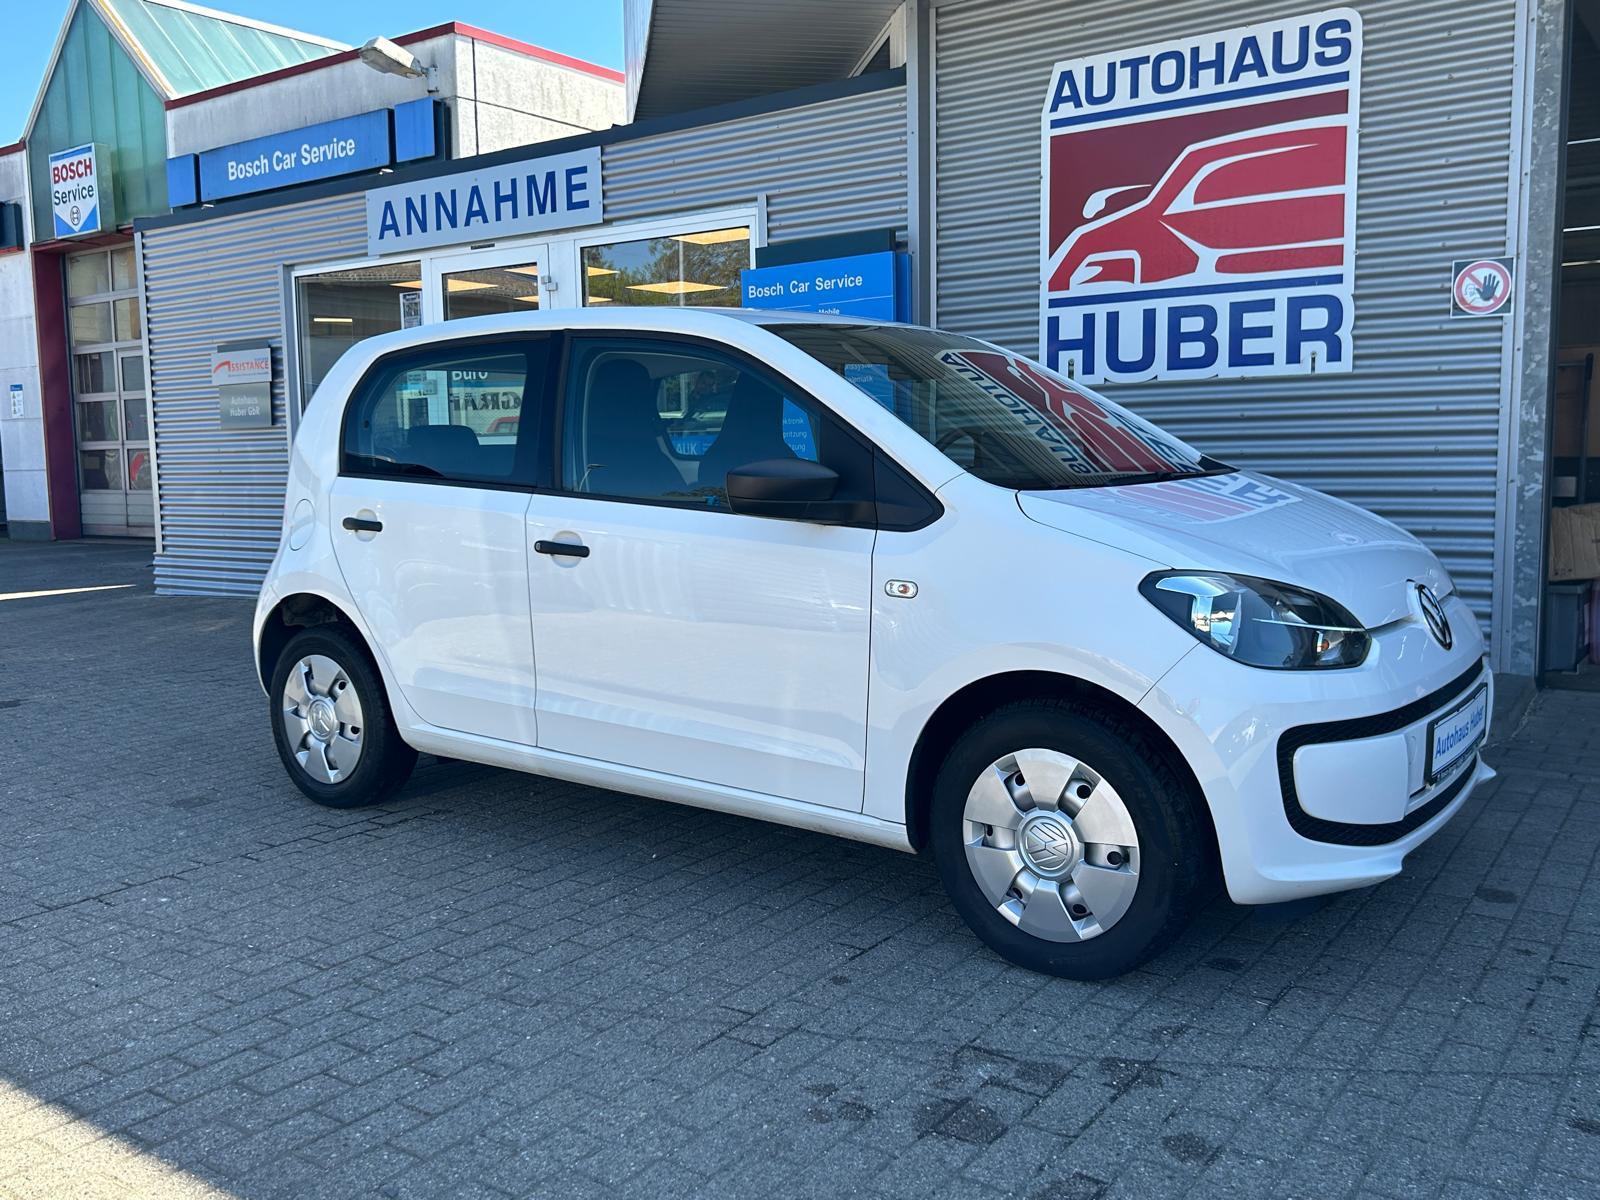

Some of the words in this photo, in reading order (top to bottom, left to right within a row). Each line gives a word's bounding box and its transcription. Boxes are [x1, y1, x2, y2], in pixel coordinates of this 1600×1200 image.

[1050, 18, 1352, 113] AUTOHAUS
[52, 157, 93, 185] BOSCH
[228, 154, 269, 180] Bosch
[272, 150, 297, 172] Car
[301, 137, 356, 166] Service
[53, 183, 95, 206] Service
[378, 165, 590, 240] ANNAHME
[748, 282, 784, 298] Bosch
[789, 280, 810, 294] Car
[815, 274, 863, 291] Service
[1047, 294, 1344, 376] HUBER
[1435, 722, 1469, 760] Autohaus
